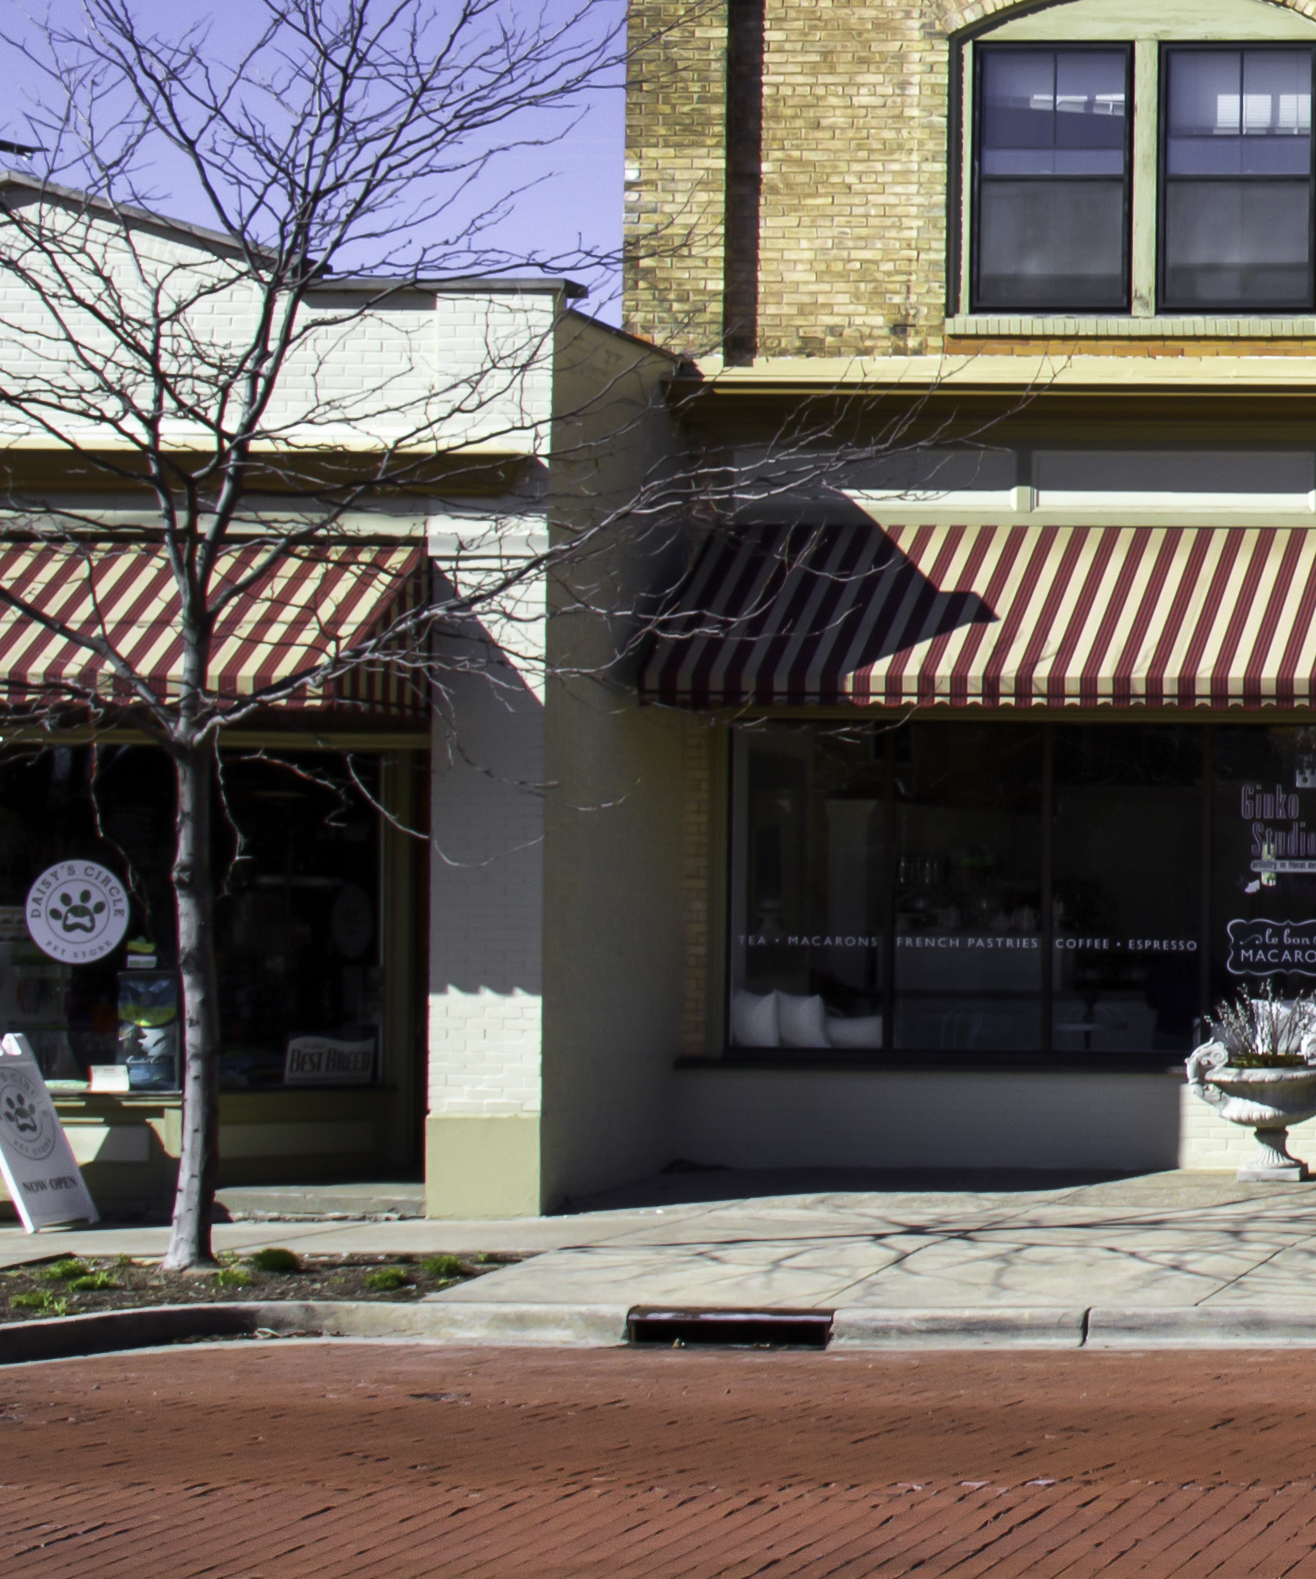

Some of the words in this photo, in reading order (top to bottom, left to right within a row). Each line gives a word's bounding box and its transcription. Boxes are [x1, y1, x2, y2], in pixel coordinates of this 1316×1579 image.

[1241, 783, 1300, 820] Ginko
[30, 865, 76, 918] DAISY'S
[84, 866, 125, 918] CIRCLE
[738, 935, 767, 946] TEA
[787, 935, 878, 947] MACARONS
[896, 937, 960, 948] FRENCH
[967, 937, 1039, 949] PASTRIES
[1055, 938, 1110, 949] COFFEE
[1128, 939, 1198, 951] ESPRESSO
[1265, 928, 1279, 945] le
[1283, 928, 1311, 945] bon
[45, 940, 67, 956] PET
[73, 940, 112, 959] STORE
[22, 1179, 48, 1194] NOW
[49, 1175, 78, 1191] OPEN
